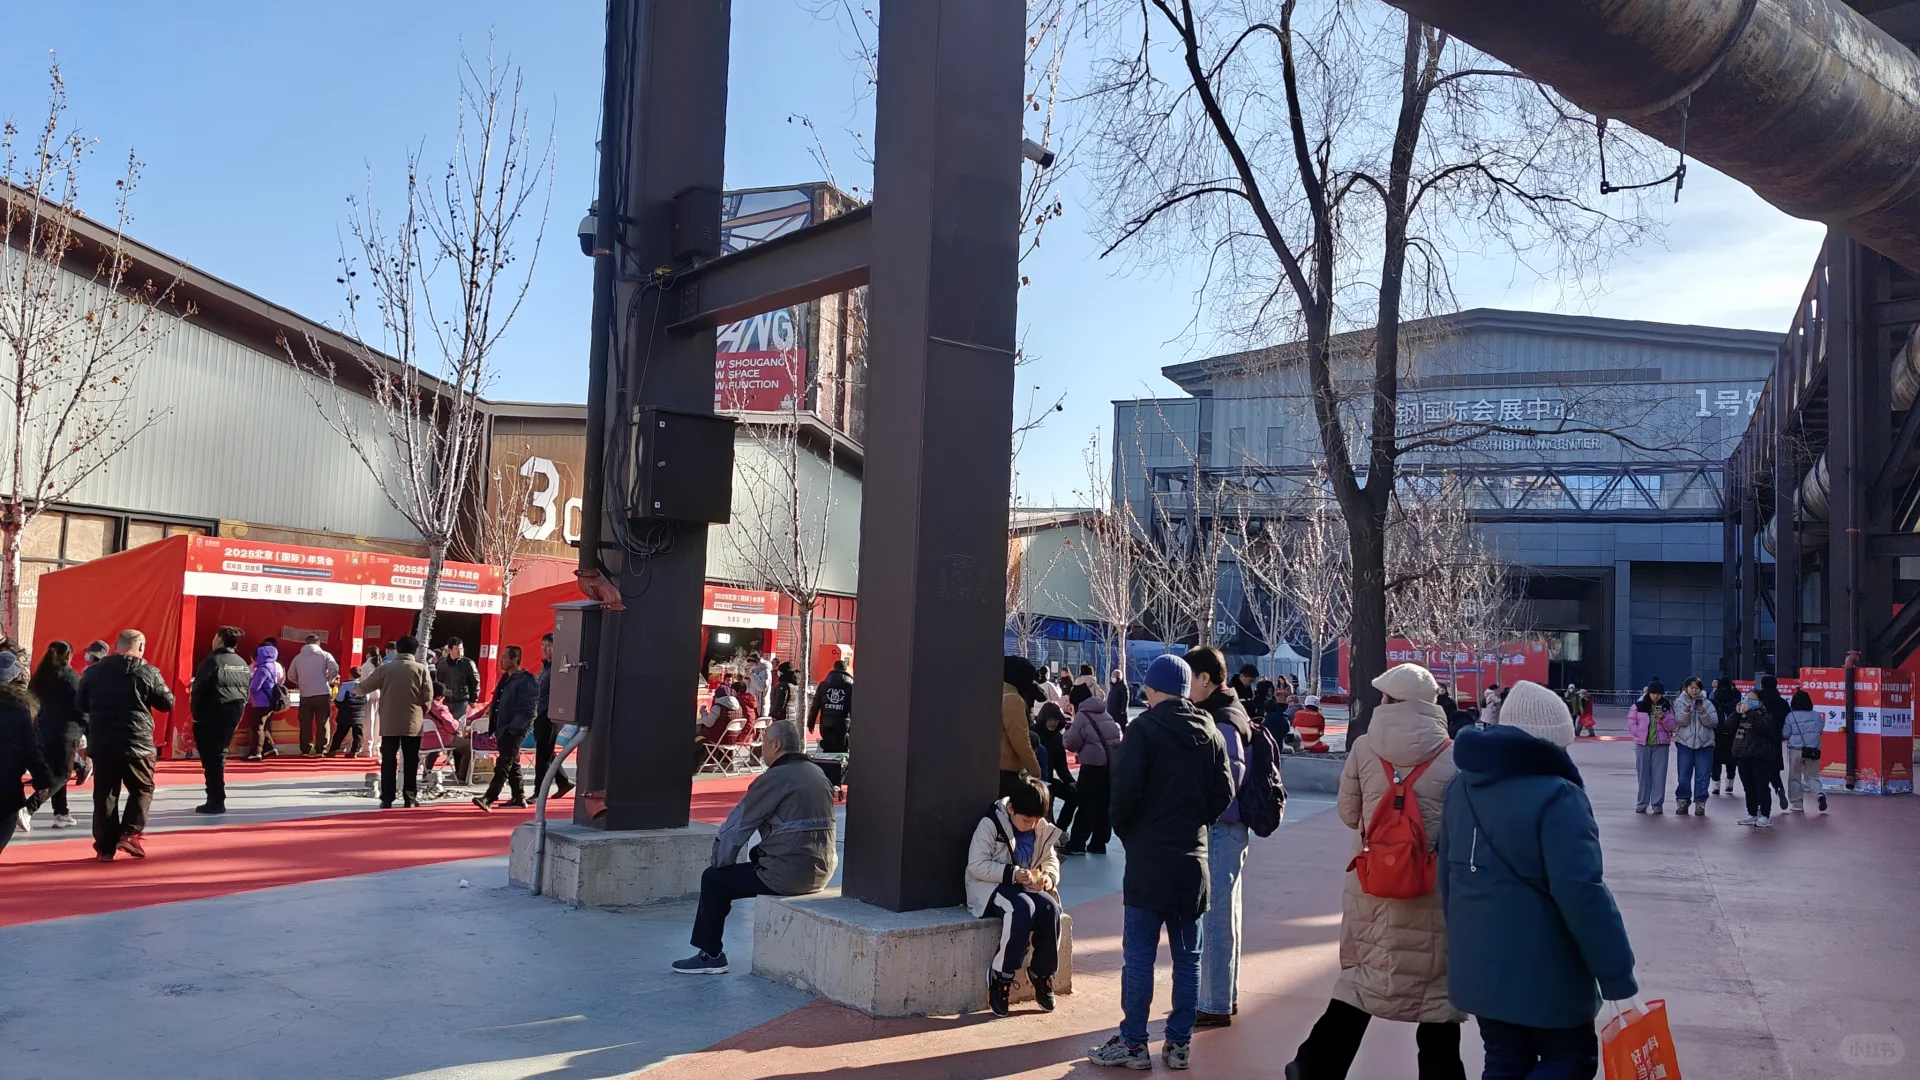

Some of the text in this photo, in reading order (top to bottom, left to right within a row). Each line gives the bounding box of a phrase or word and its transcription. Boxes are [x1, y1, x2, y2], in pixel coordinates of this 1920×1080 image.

[716, 311, 794, 353] ANG
[728, 370, 760, 378] SPACE
[728, 380, 779, 389] FUNCTION
[1395, 398, 1579, 424] 钢国际会展中心
[1803, 681, 1878, 692] 2025北京国际）
[1824, 691, 1845, 699] 年货
